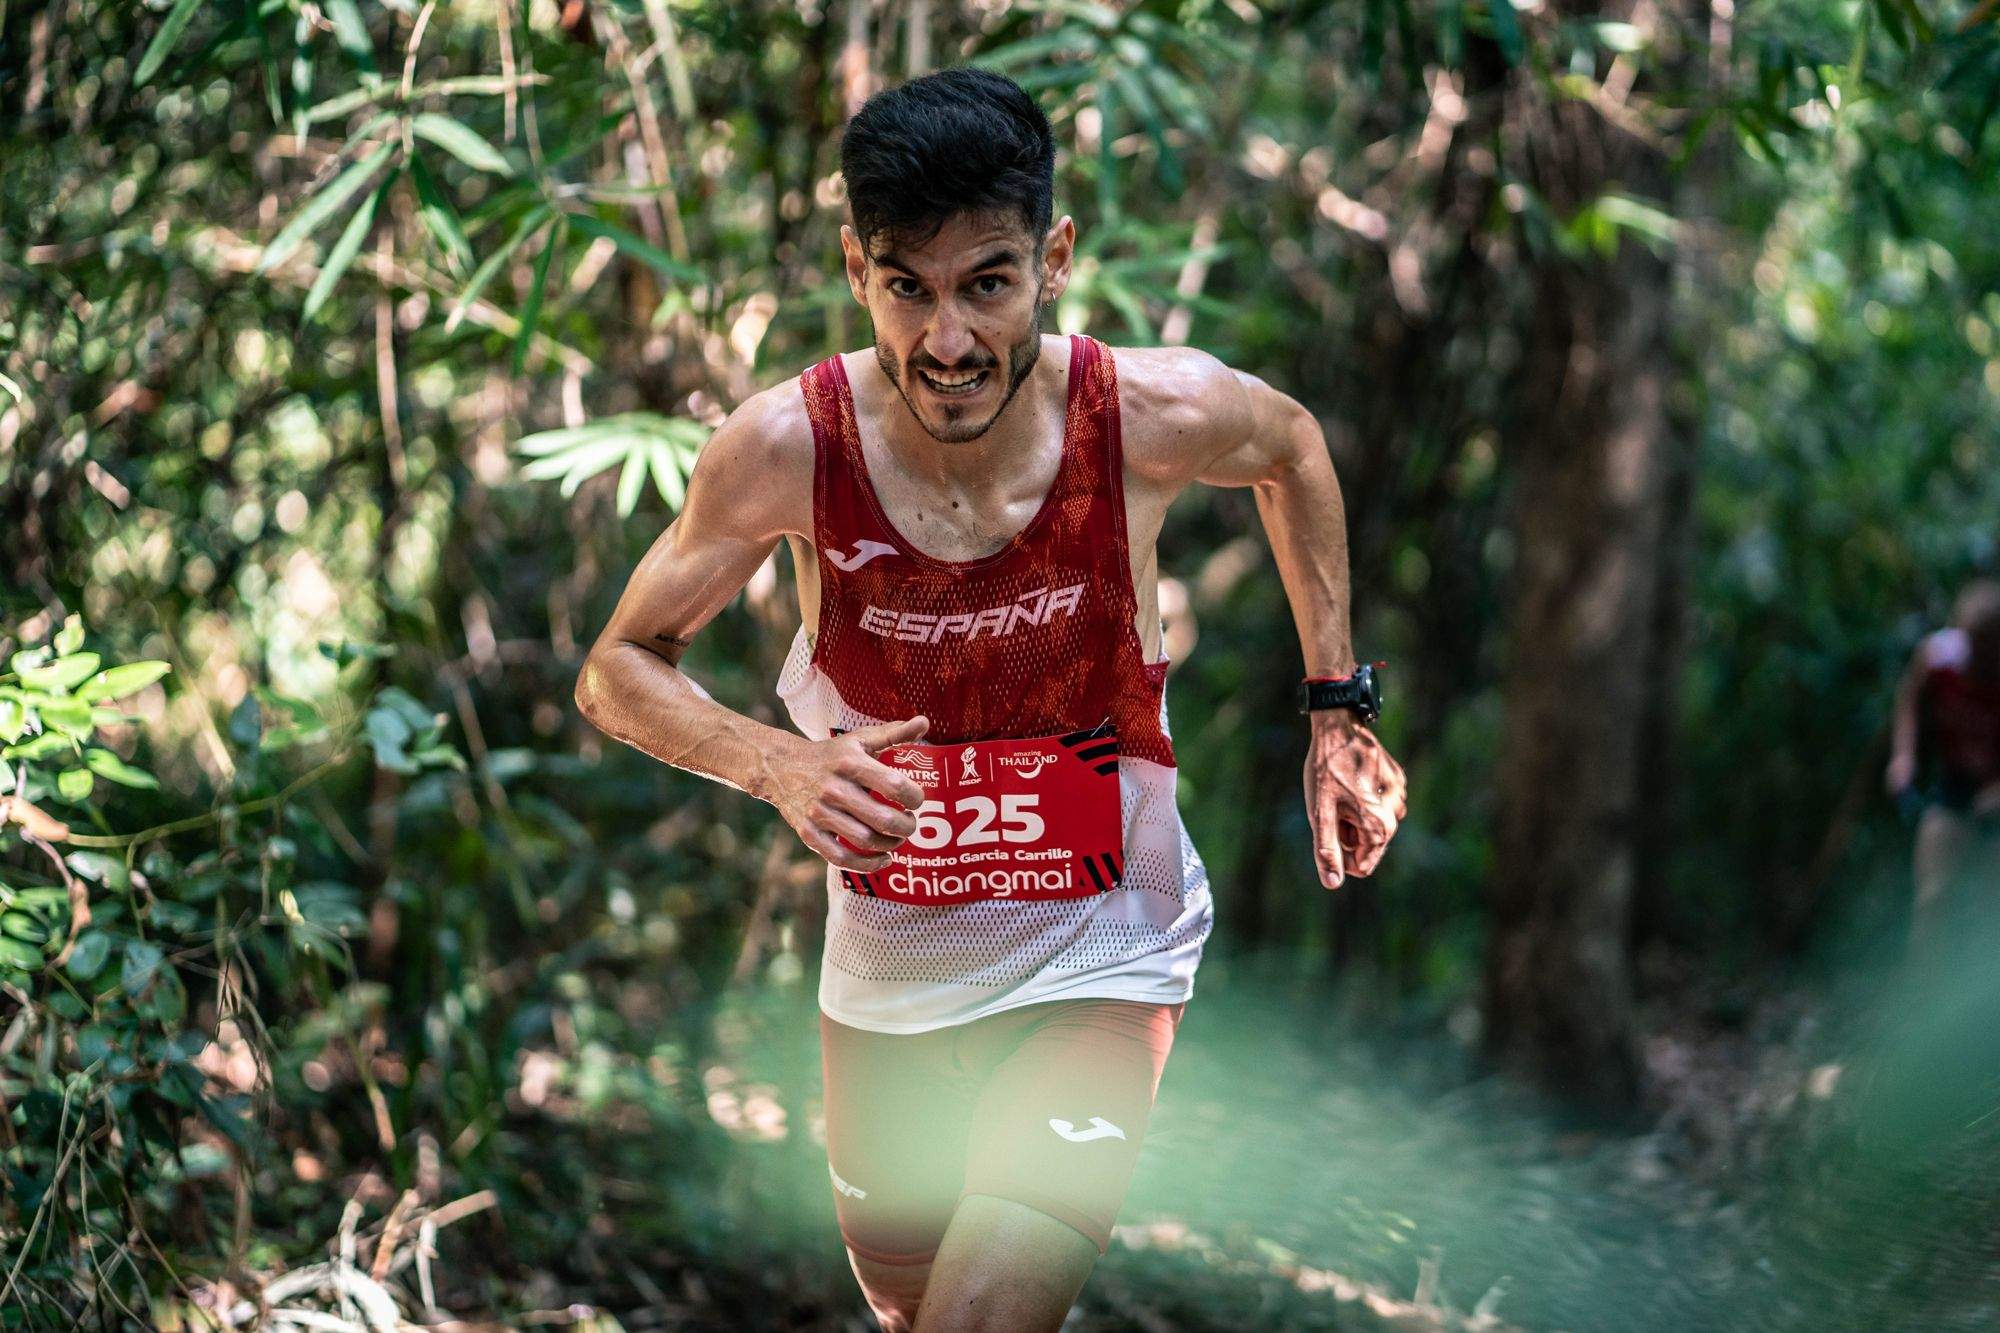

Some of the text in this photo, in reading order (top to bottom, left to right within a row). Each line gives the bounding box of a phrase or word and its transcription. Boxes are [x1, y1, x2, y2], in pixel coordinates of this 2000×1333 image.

[859, 583, 1085, 644] ESPAÑA
[998, 754, 1058, 766] THAILAND
[908, 794, 1045, 849] 625
[1014, 848, 1073, 860] Carrillo
[888, 863, 1072, 897] chiangmai
